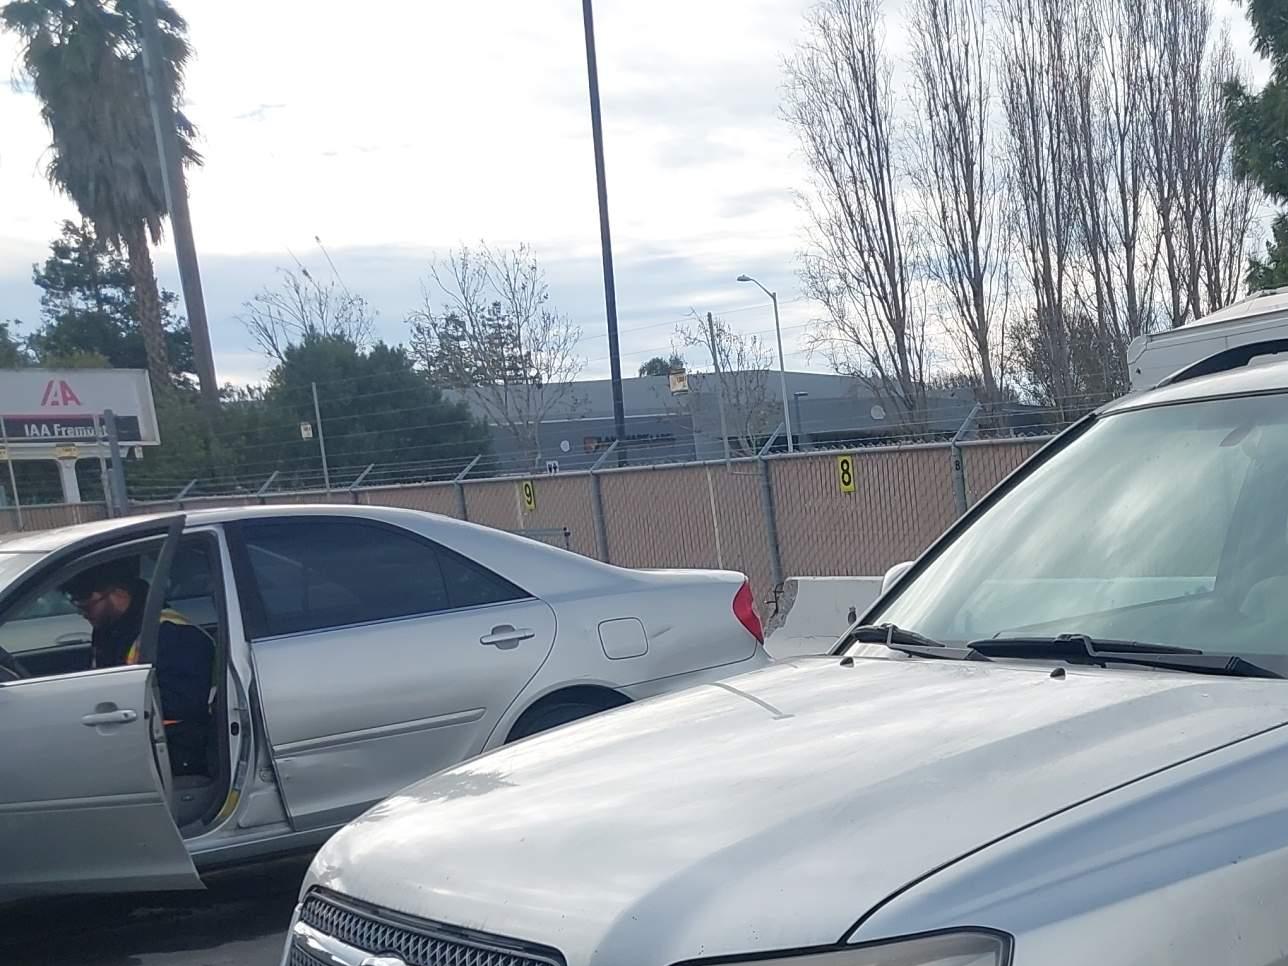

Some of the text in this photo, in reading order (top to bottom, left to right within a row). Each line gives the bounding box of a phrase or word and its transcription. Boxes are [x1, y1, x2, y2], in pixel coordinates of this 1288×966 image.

[24, 423, 51, 437] IAA
[840, 459, 852, 486] 8
[524, 483, 532, 505] 9
